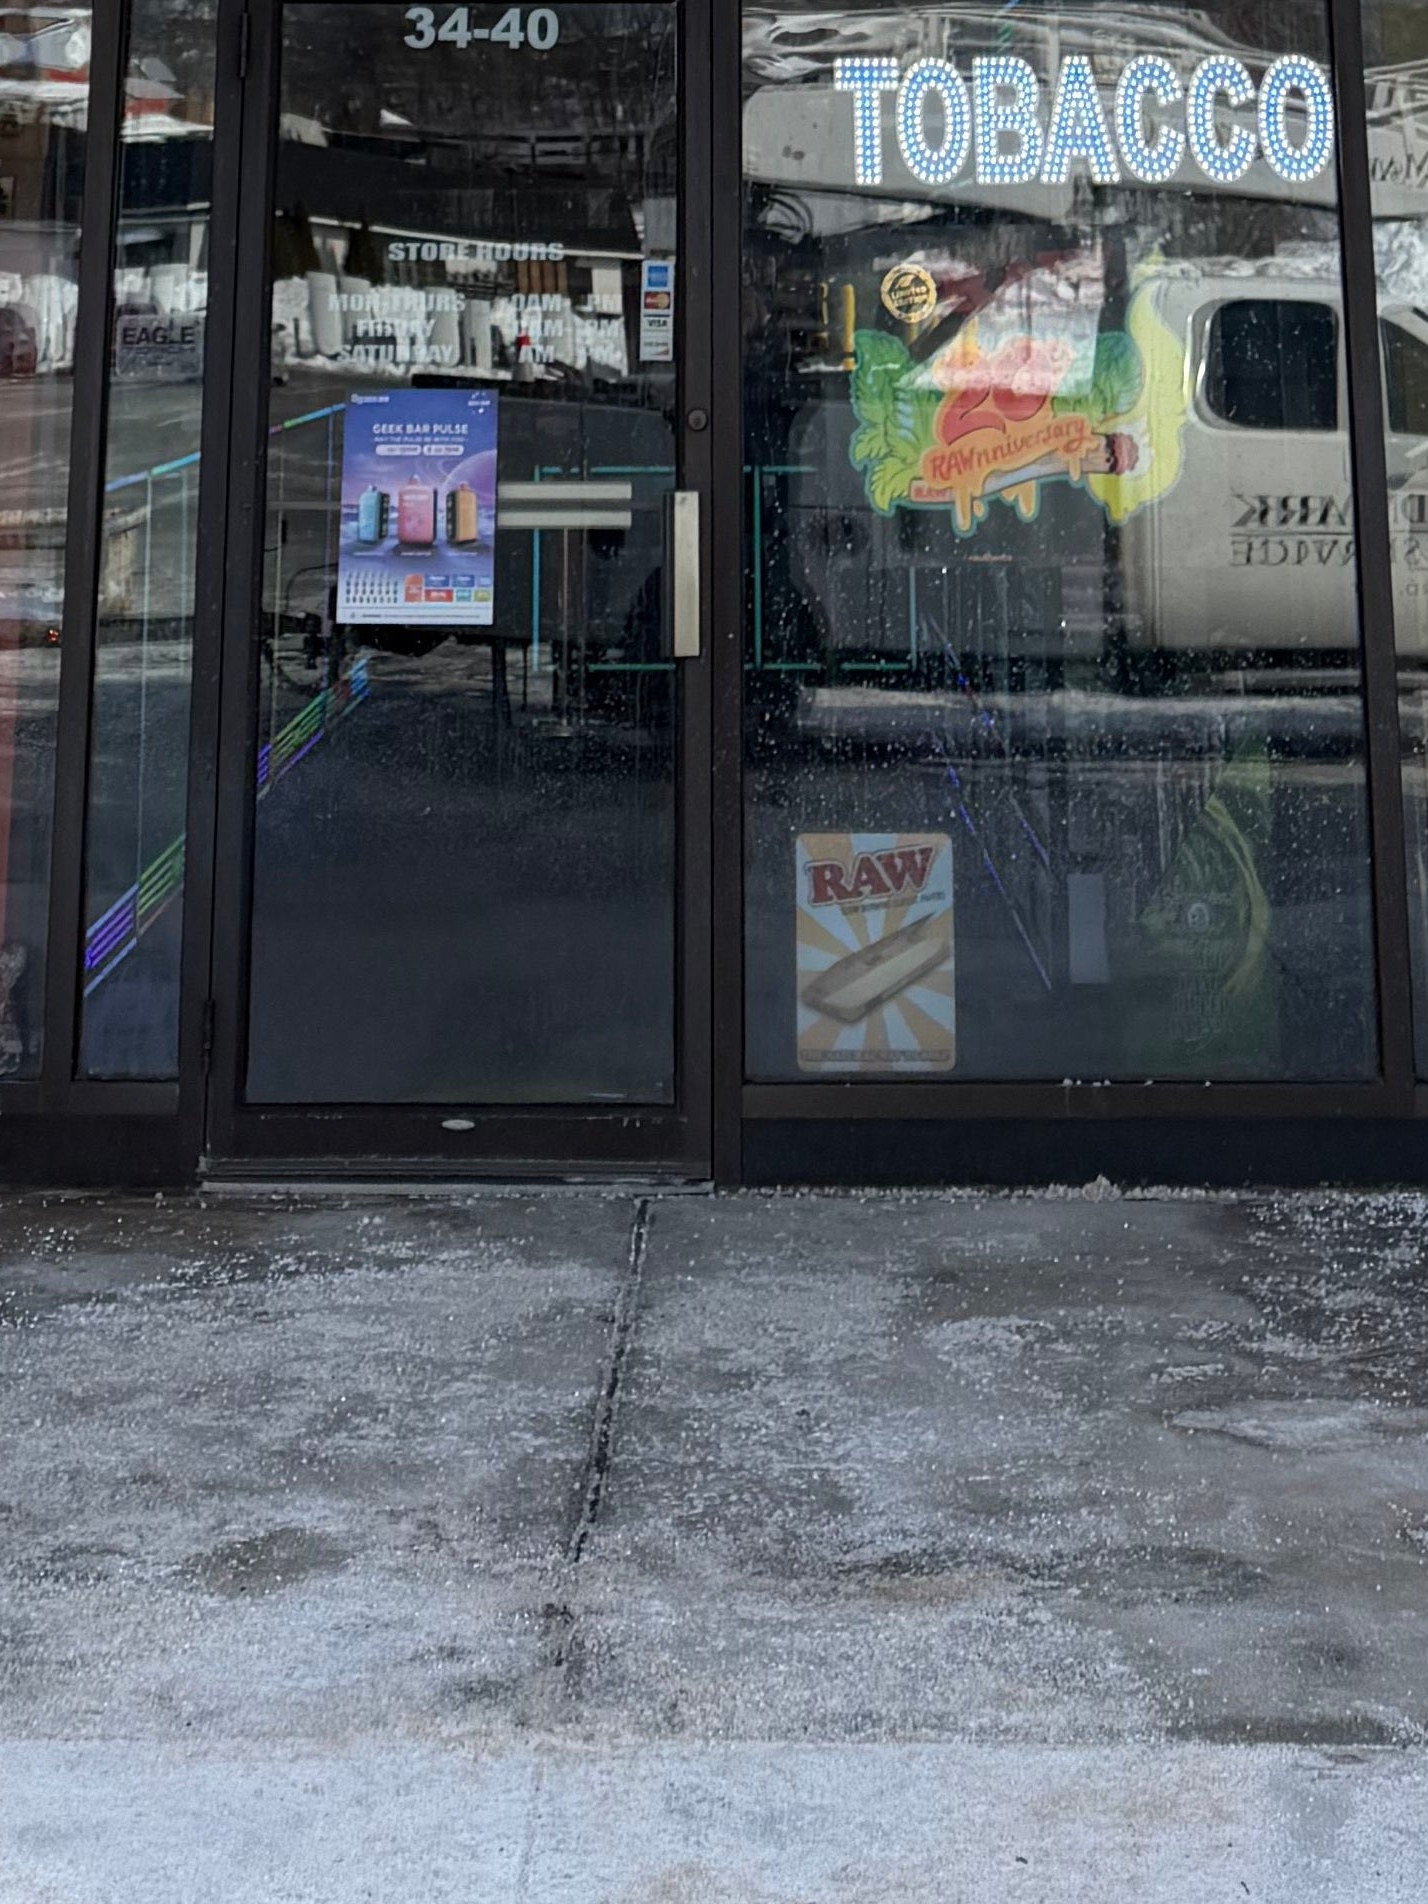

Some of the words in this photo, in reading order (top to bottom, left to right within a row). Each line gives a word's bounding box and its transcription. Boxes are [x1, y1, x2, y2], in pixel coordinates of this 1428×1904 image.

[403, 7, 559, 50] 34-40
[833, 53, 1334, 185] TOBACCO
[388, 242, 470, 262] STORE
[476, 242, 566, 262] HOURS
[122, 326, 195, 345] EAGLE
[647, 319, 668, 328] VISA
[372, 423, 404, 435] GEEK
[405, 423, 431, 435] BAR
[433, 423, 469, 435] PULSE
[931, 417, 1086, 480] RAWnniversary
[806, 845, 935, 907] RAW
